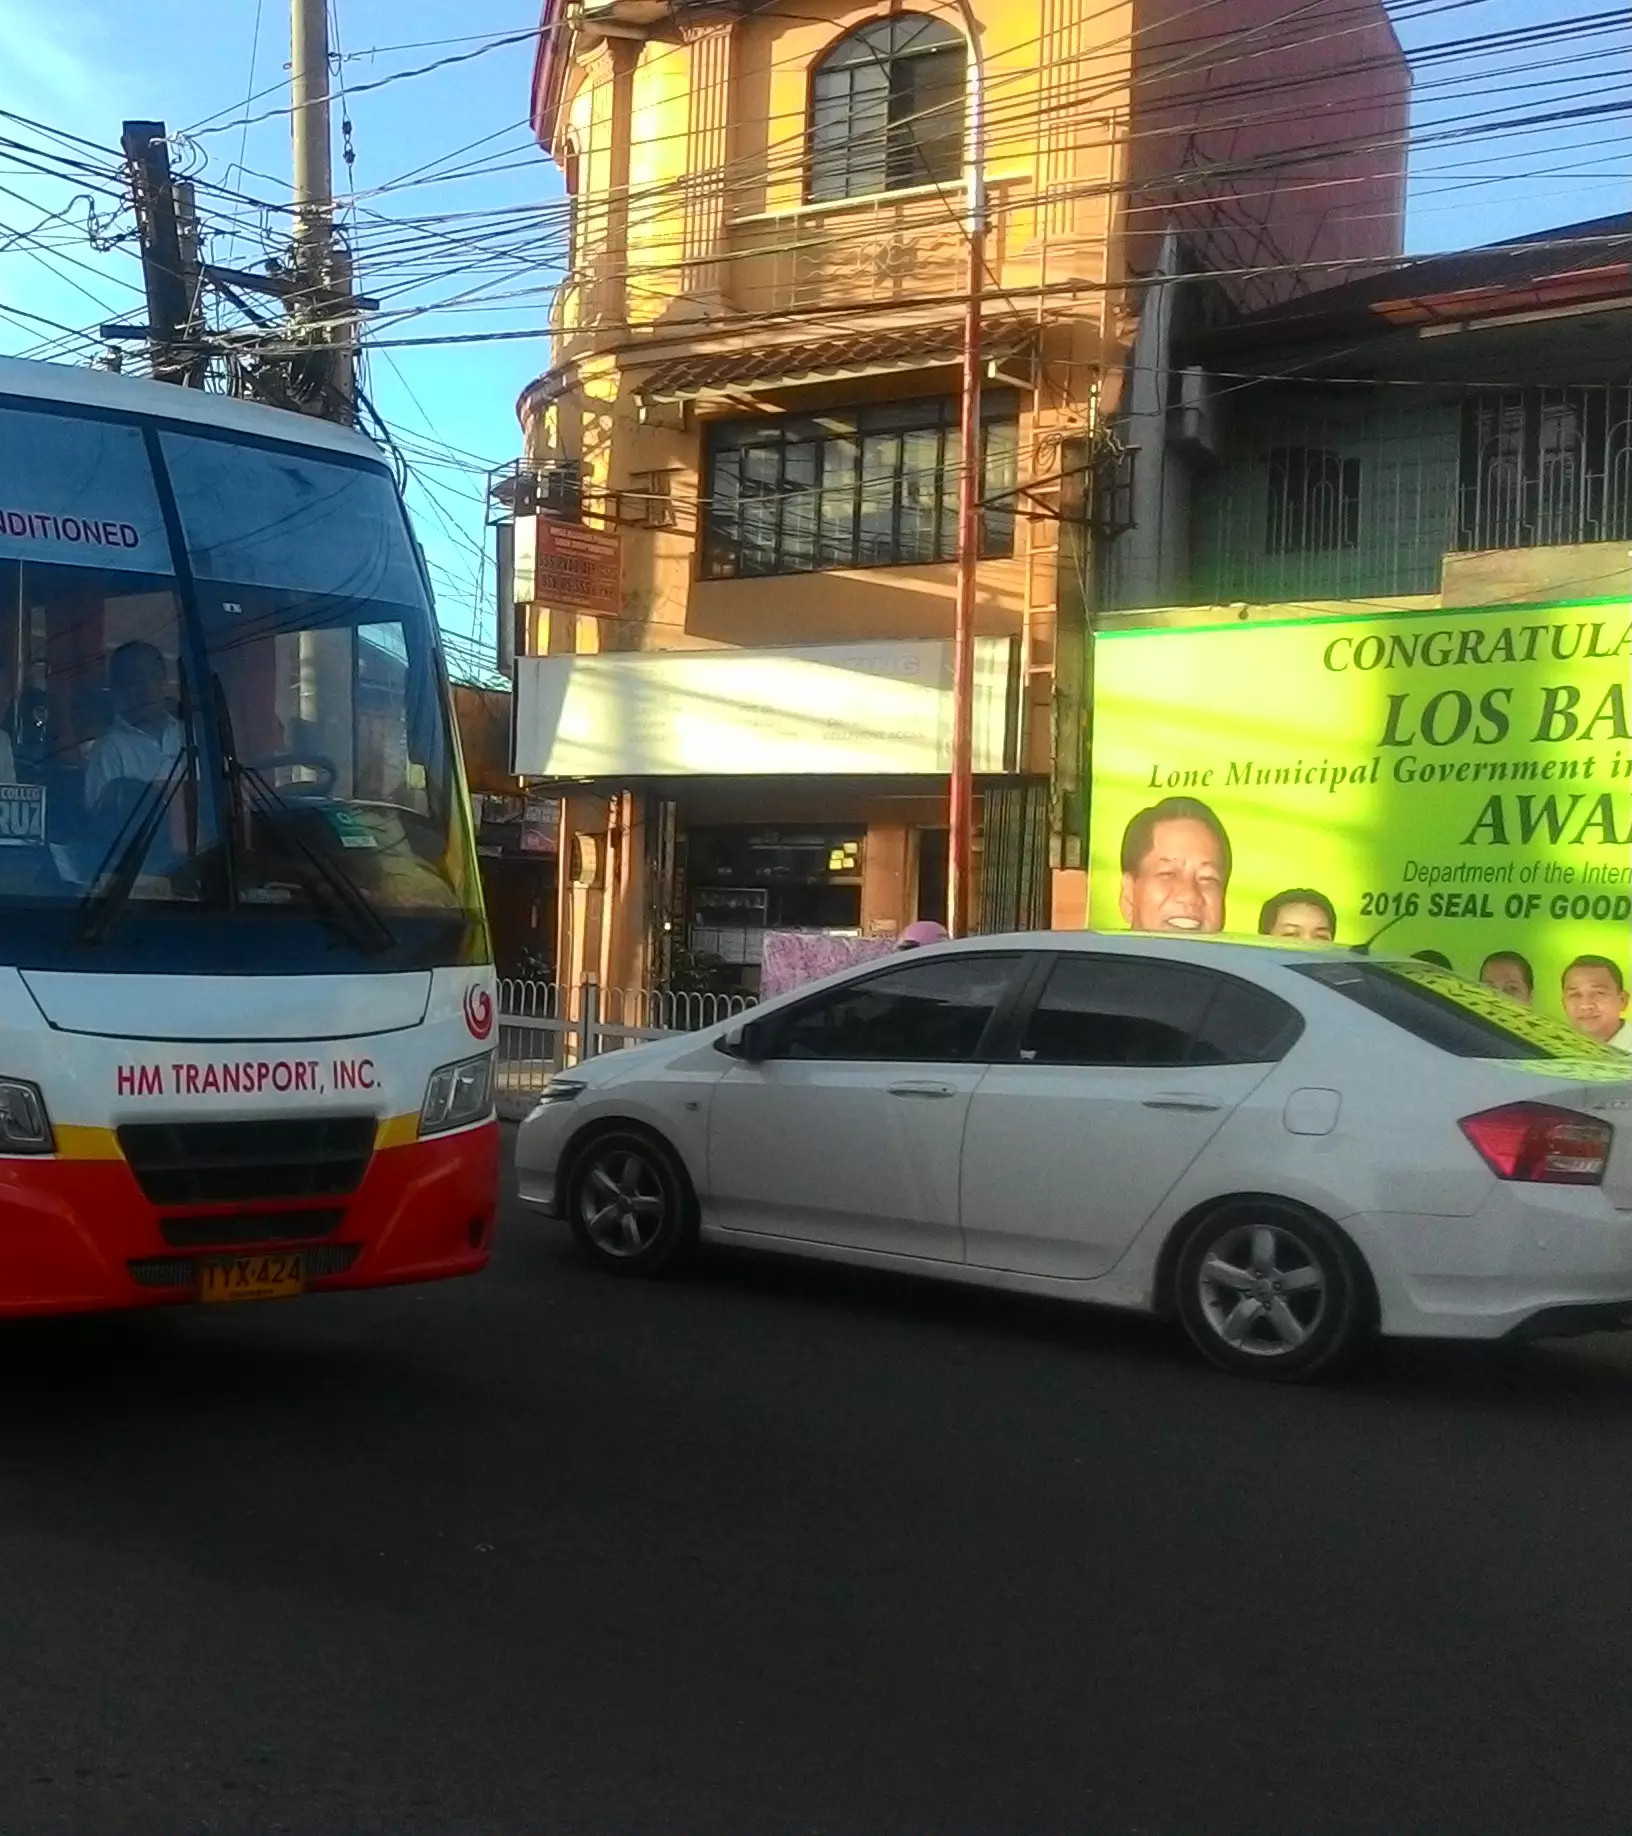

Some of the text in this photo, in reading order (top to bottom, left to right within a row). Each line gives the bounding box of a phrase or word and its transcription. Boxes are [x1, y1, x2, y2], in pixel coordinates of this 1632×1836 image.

[1377, 687, 1514, 748] LOS
[1148, 763, 1214, 789] Lone
[1225, 757, 1380, 793] Municipal
[1393, 754, 1596, 784] Government
[1402, 860, 1514, 887] Department
[1519, 860, 1541, 884] of
[1544, 861, 1575, 884] the
[1359, 891, 1632, 921] 2016 SEAL OF GOOD
[116, 1059, 382, 1097] HM TRANSPORT, INC.
